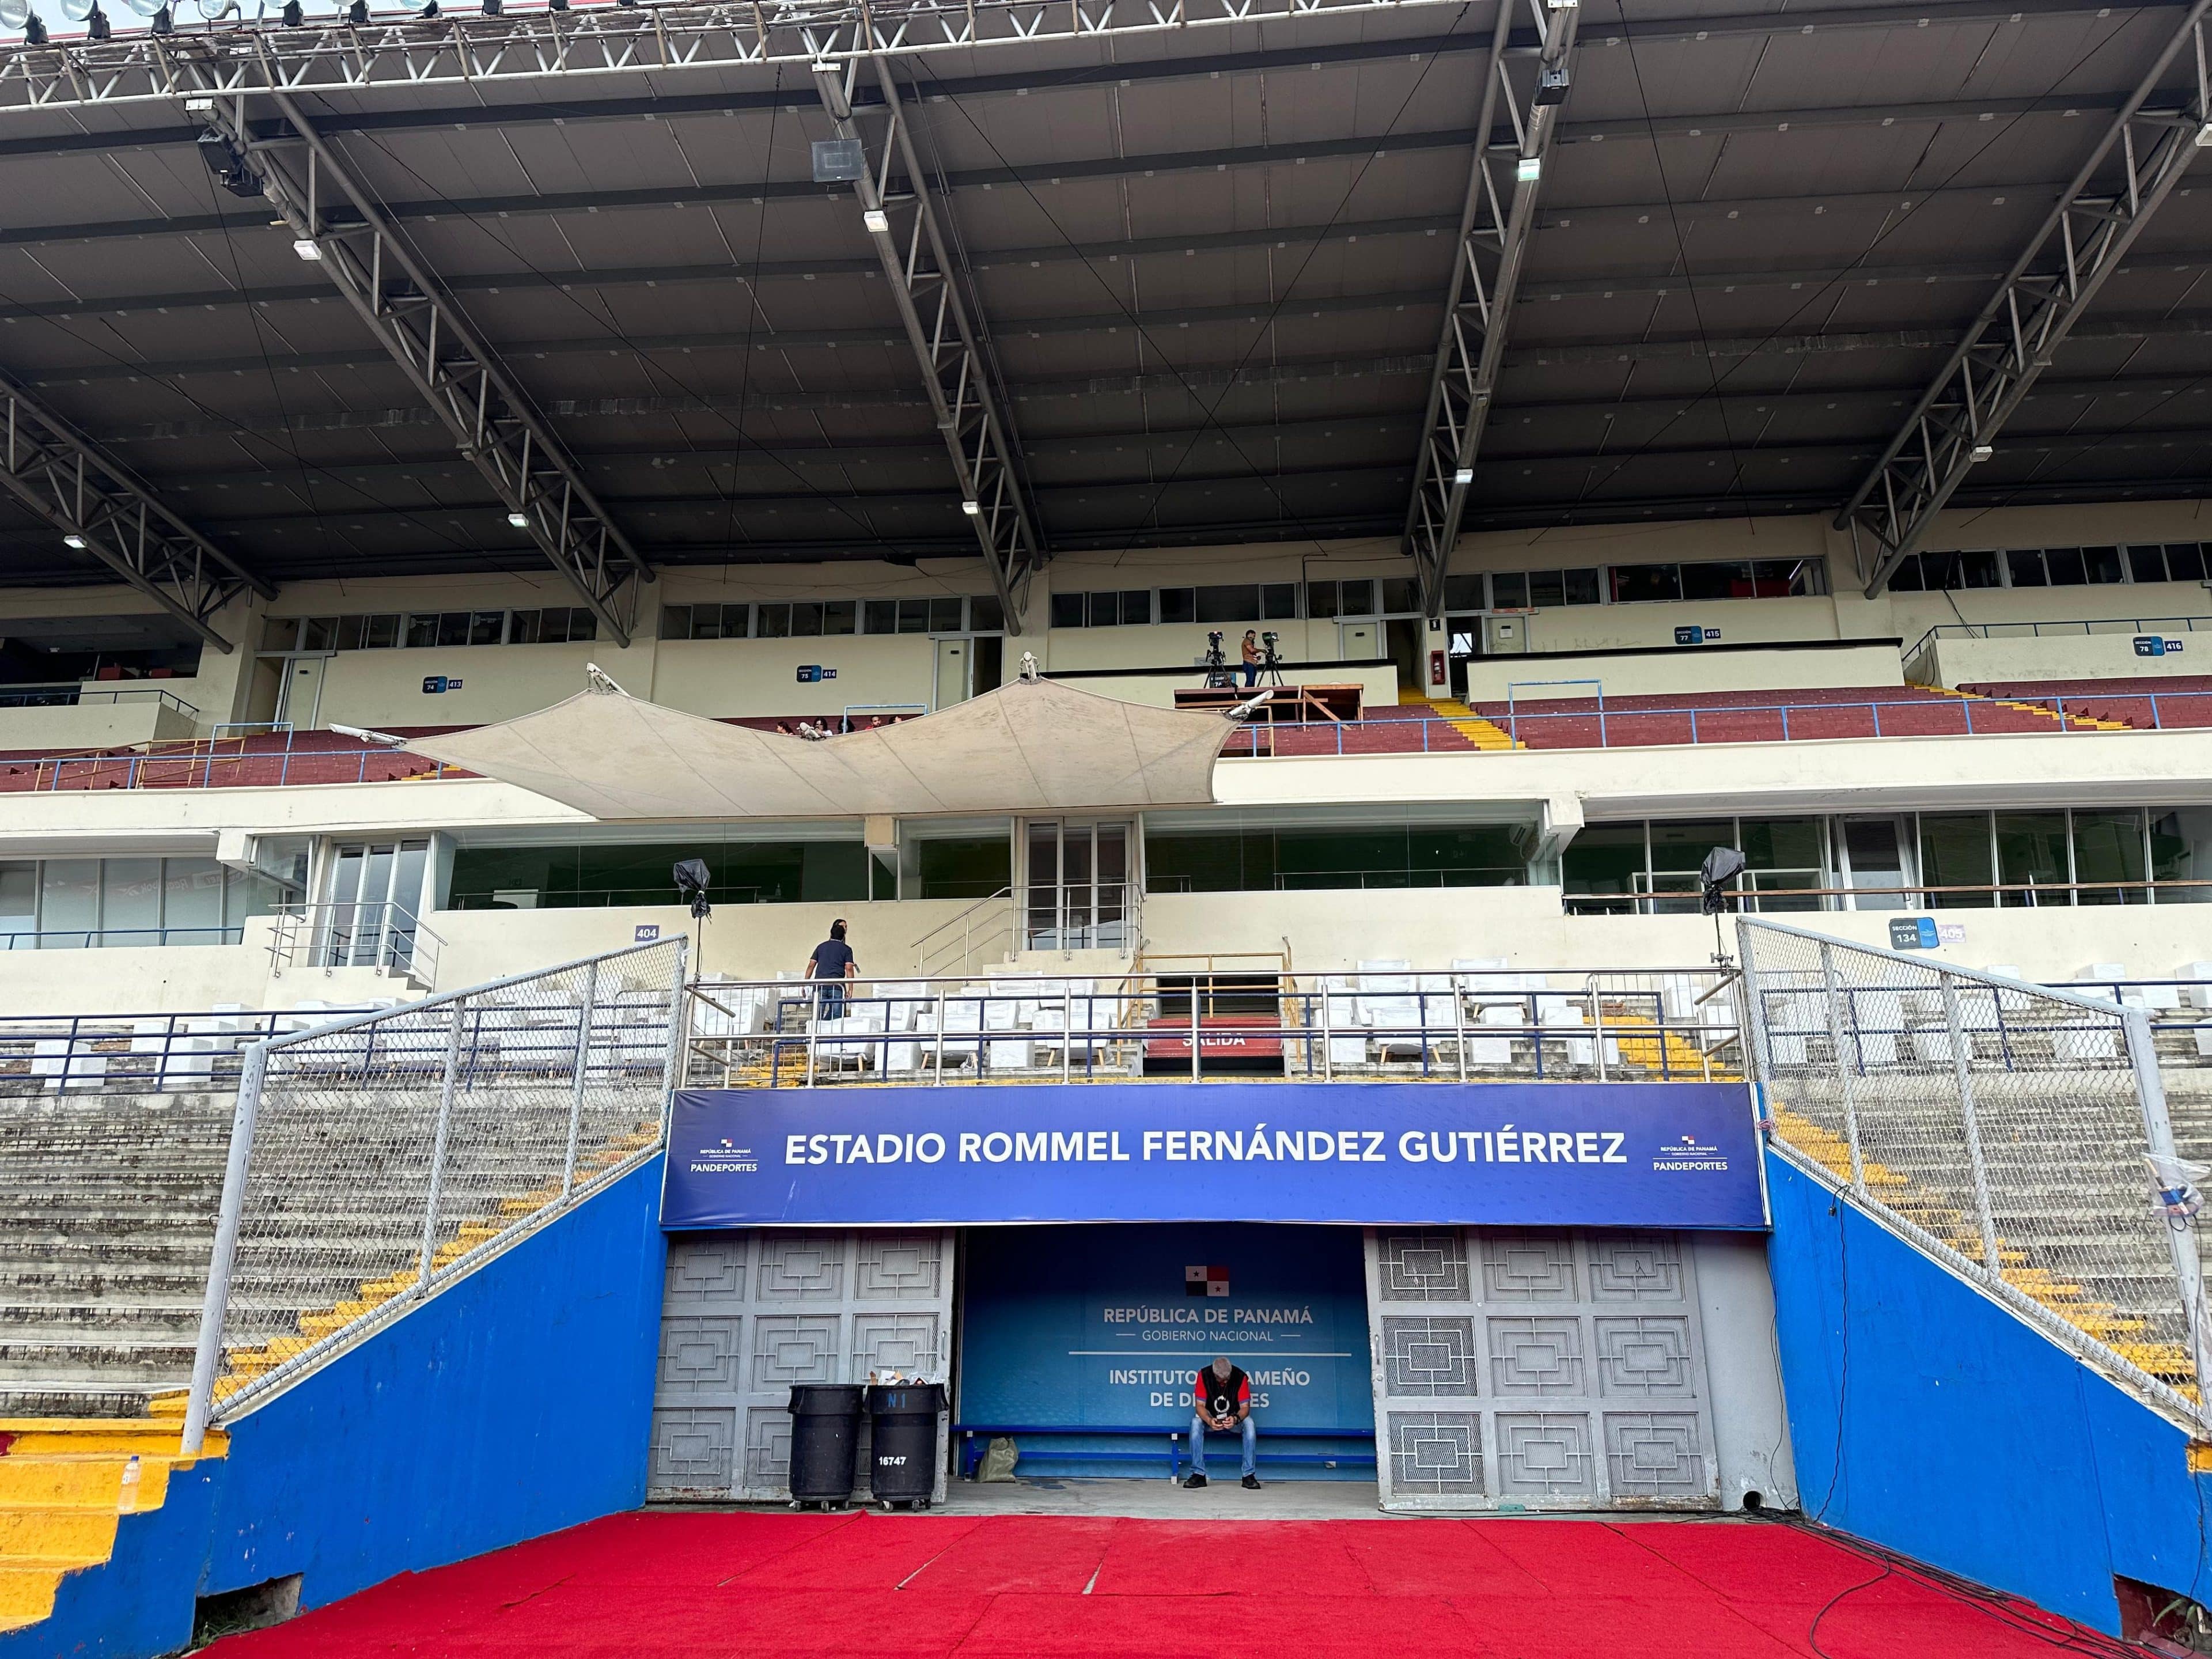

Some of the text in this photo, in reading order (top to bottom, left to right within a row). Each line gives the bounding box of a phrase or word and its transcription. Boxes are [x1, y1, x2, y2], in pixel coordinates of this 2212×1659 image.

[637, 929, 657, 938] 404
[1897, 934, 1916, 942] 134
[1940, 929, 1963, 939] 405
[786, 1124, 1627, 1164] ESTADIO ROMMEL FERNÁNDEZ GUTIÉRREZ
[691, 1164, 757, 1172] PANDEPORTES
[1653, 1161, 1728, 1171] PANDEPORTES
[1104, 1305, 1313, 1324] REPÚBLICA DE PANAMÁ
[1142, 1330, 1274, 1342] GOBIERNO NACIONAL
[1109, 1370, 1198, 1385] INSTITUTO
[888, 1393, 906, 1408] N 1
[1150, 1392, 1173, 1407] DE
[878, 1456, 907, 1465] 16747
